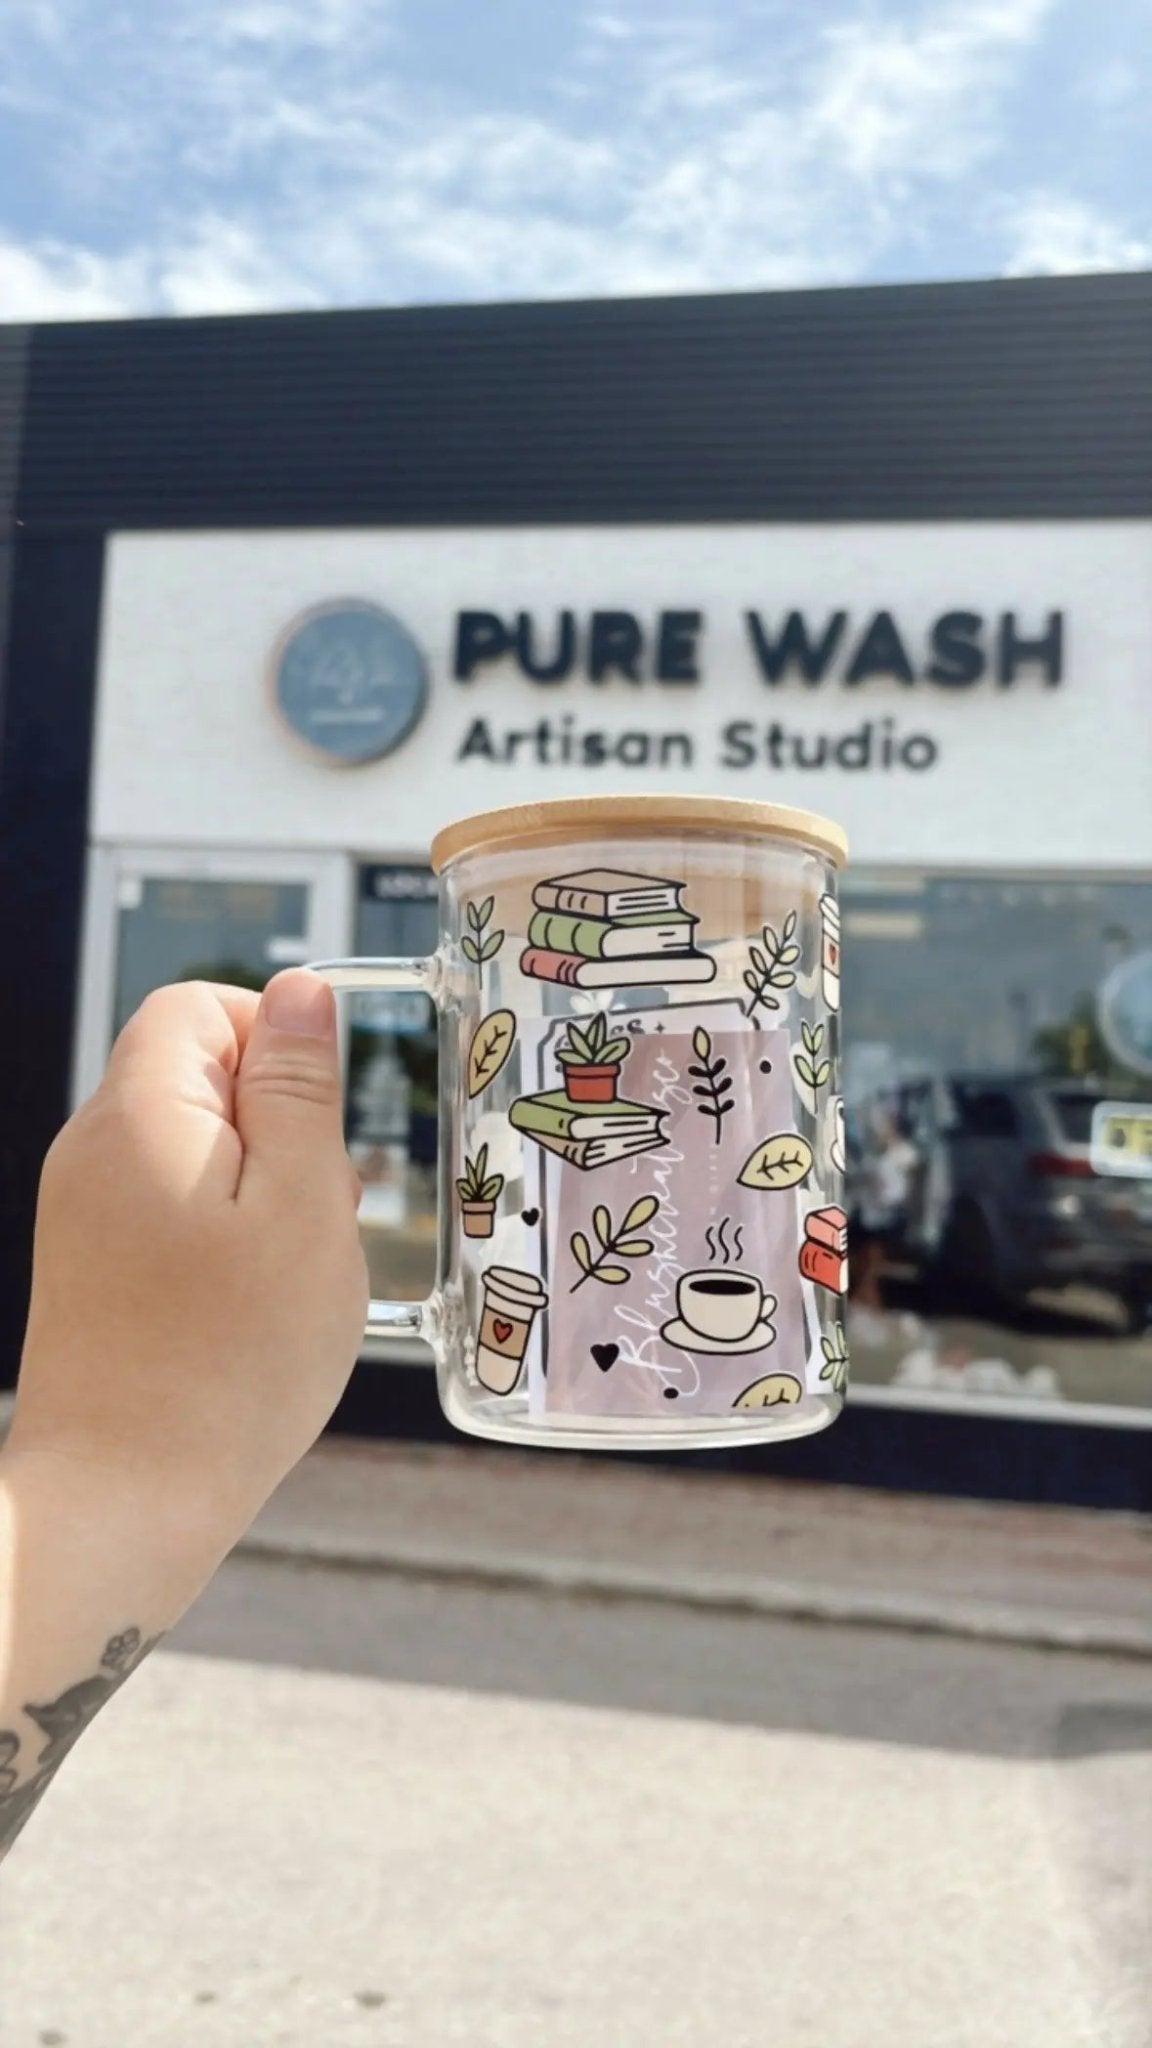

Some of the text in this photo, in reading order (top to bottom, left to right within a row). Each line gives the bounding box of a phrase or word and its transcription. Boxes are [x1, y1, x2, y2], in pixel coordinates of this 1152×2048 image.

[451, 609, 1064, 690] PURE WASH
[459, 717, 937, 769] Artisan Studio
